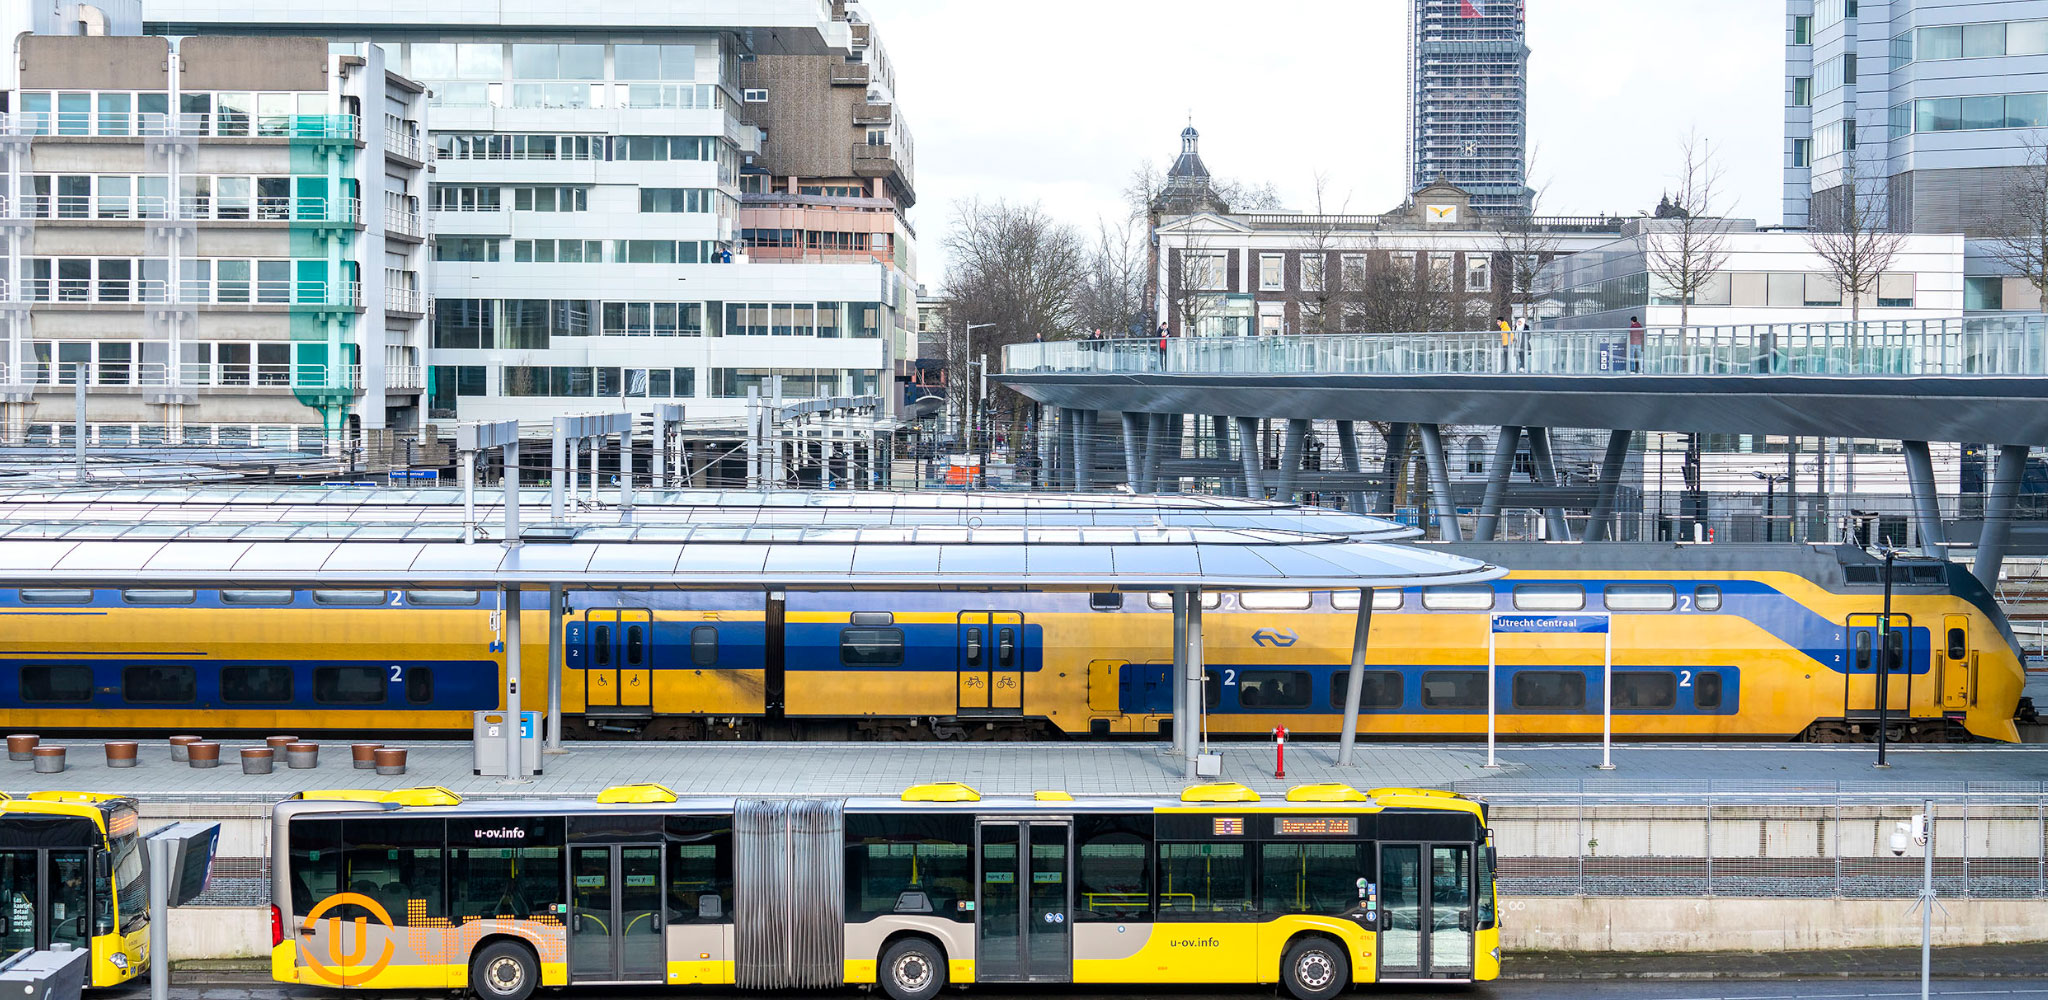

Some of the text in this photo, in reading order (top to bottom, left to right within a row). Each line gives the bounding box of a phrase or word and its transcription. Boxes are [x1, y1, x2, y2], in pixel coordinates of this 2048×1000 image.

[390, 590, 402, 606] 2
[1224, 594, 1236, 611] 2
[1679, 595, 1692, 612] 2
[1498, 618, 1577, 628] Utrecht Centraal
[572, 627, 579, 636] 2
[1834, 633, 1840, 641] 2
[572, 649, 579, 657] 2
[1834, 654, 1840, 662] 2
[390, 665, 402, 682] 2
[1224, 669, 1236, 686] 2
[1679, 670, 1692, 687] 2
[474, 826, 525, 839] u-ov.info
[1170, 936, 1220, 947] u-ov.info
